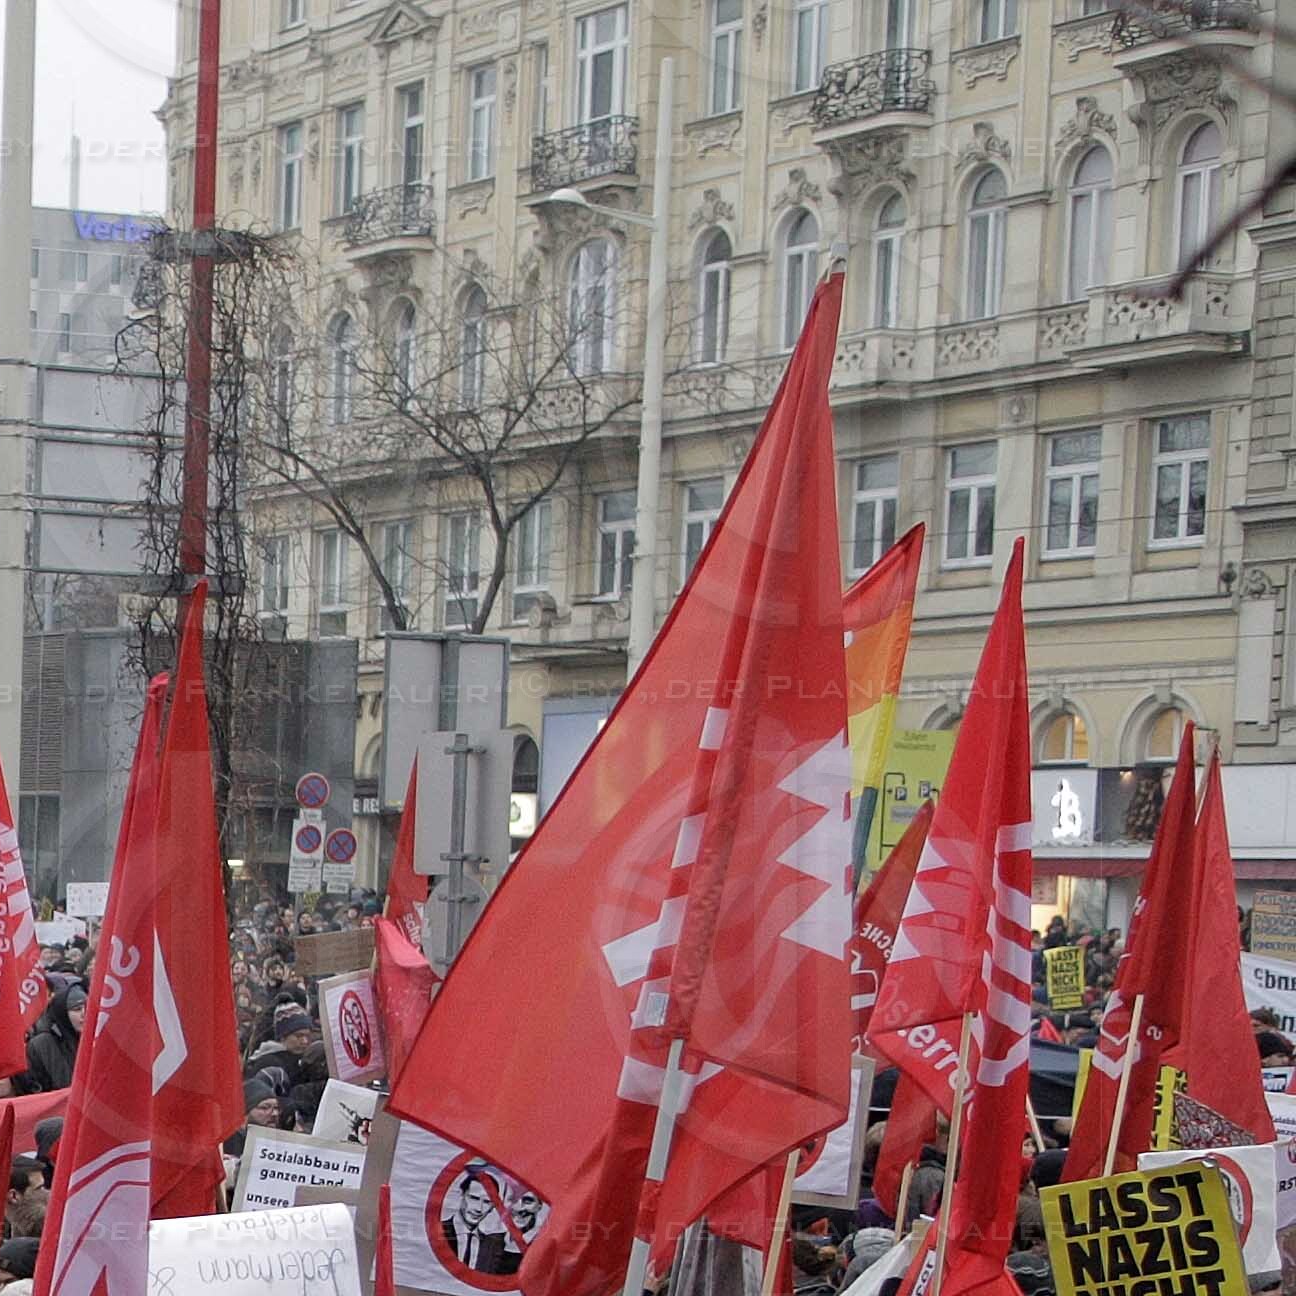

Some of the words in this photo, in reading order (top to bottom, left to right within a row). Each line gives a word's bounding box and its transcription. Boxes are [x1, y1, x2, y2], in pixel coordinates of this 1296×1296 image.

[1049, 948, 1083, 962] LASST
[1049, 960, 1081, 974] NAZIS
[1049, 974, 1081, 986] NICHT
[258, 1148, 340, 1171] Sozialabbau
[343, 1165, 360, 1175] im
[259, 1168, 306, 1184] ganzen
[310, 1174, 345, 1187] Land
[246, 1192, 290, 1208] unsere
[1057, 1170, 1204, 1239] LASST
[1066, 1219, 1221, 1288] NAZIS
